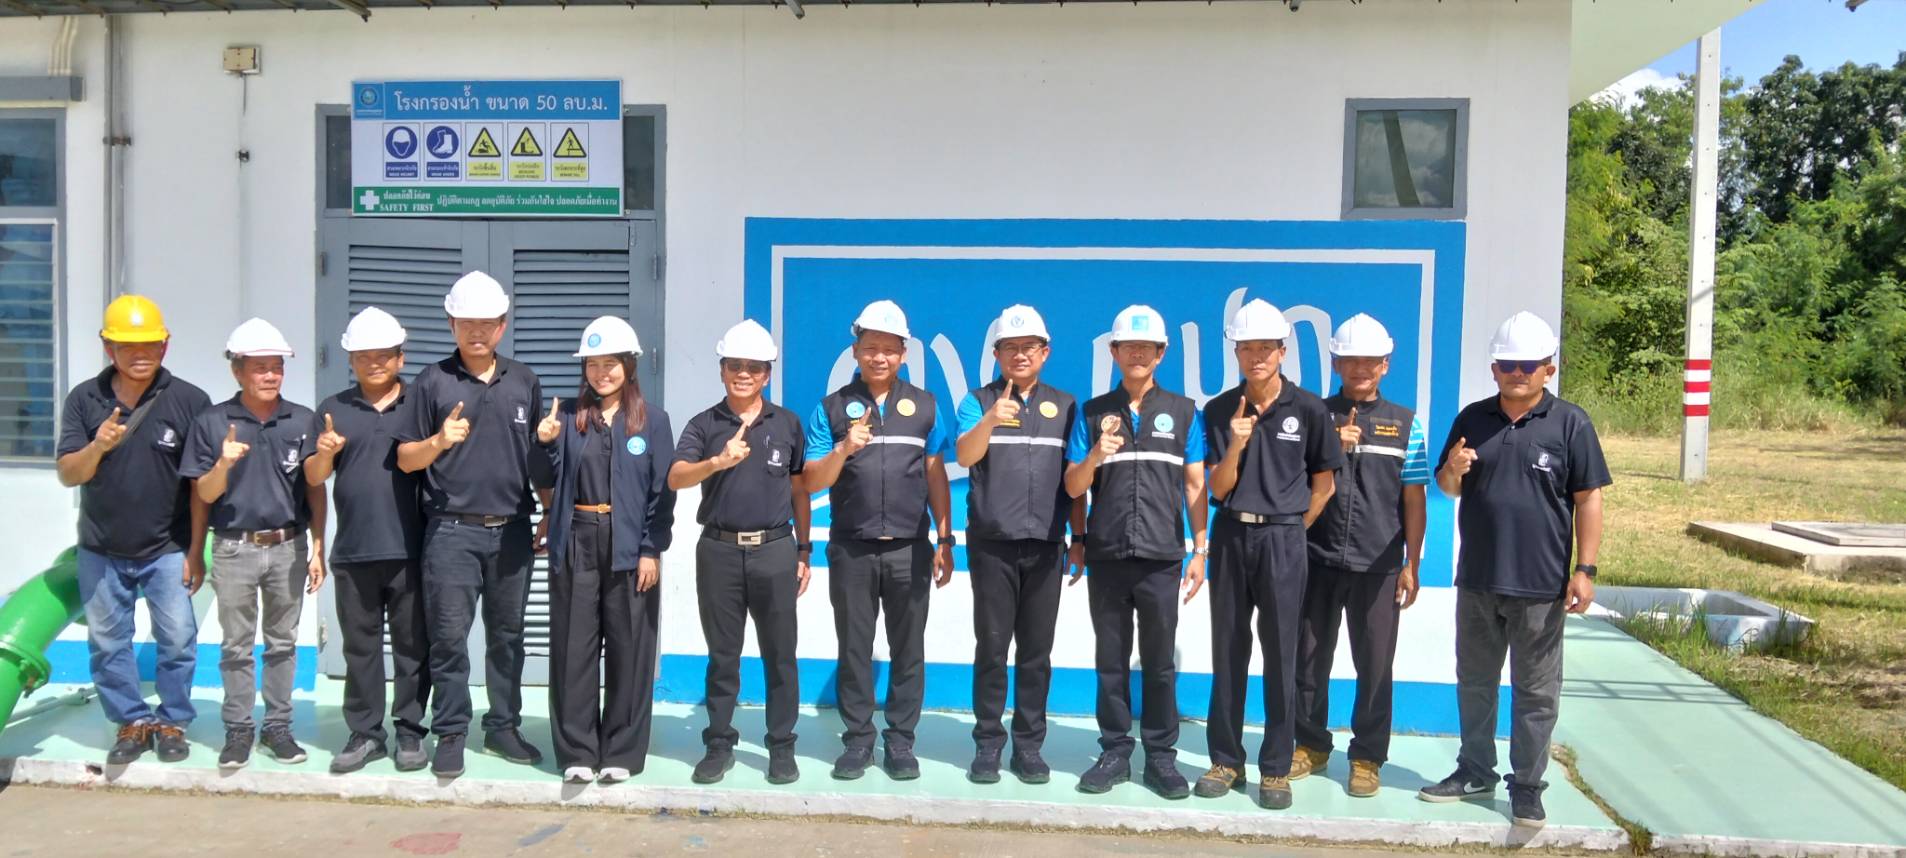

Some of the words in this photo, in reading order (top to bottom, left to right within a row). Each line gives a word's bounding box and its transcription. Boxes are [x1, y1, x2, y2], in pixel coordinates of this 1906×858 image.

[394, 85, 479, 111] โรงกรองน้ำ
[486, 96, 529, 110] ขนาด
[537, 95, 557, 110] 50
[563, 96, 608, 111] ลบ.ม.
[380, 203, 408, 212] SAFETY
[412, 203, 434, 212] FIRST
